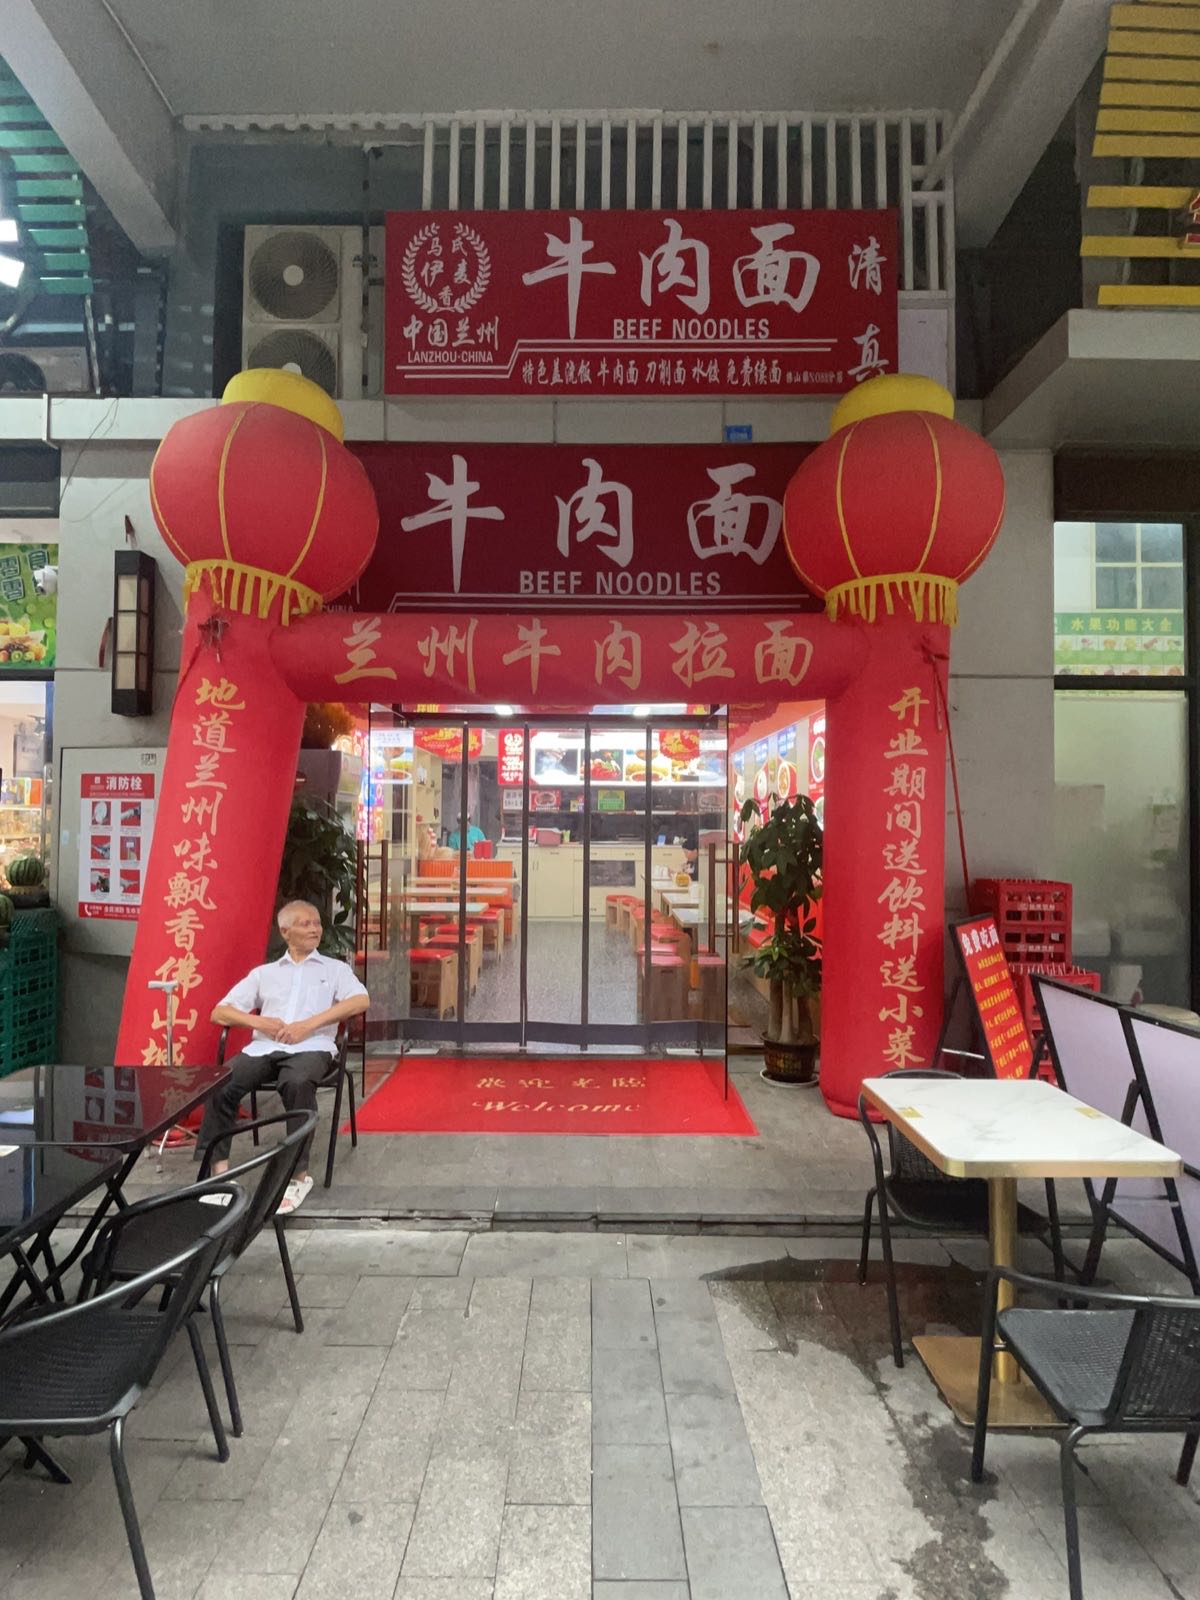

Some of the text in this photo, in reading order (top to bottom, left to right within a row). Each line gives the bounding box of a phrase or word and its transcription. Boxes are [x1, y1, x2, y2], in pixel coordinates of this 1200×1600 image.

[522, 216, 821, 340] 牛肉面
[848, 235, 889, 382] 清真
[403, 313, 499, 351] 中国兰州
[613, 318, 770, 340] BEEF NOODLES
[597, 357, 639, 386] 牛肉面
[645, 358, 686, 386] 刀削面
[691, 357, 720, 384] 水饺
[726, 355, 782, 387] 免费续面
[400, 454, 783, 594] 牛肉面
[519, 571, 721, 596] BEEF NOODLES
[1071, 617, 1172, 632] 水果功能大全
[334, 616, 814, 694] 兰州牛肉拉面
[105, 775, 143, 791] 消防栓
[877, 686, 930, 1069] 开业期间送饮料送小菜
[961, 924, 1000, 957] 免费吃面
[471, 1101, 641, 1112] Welcome
